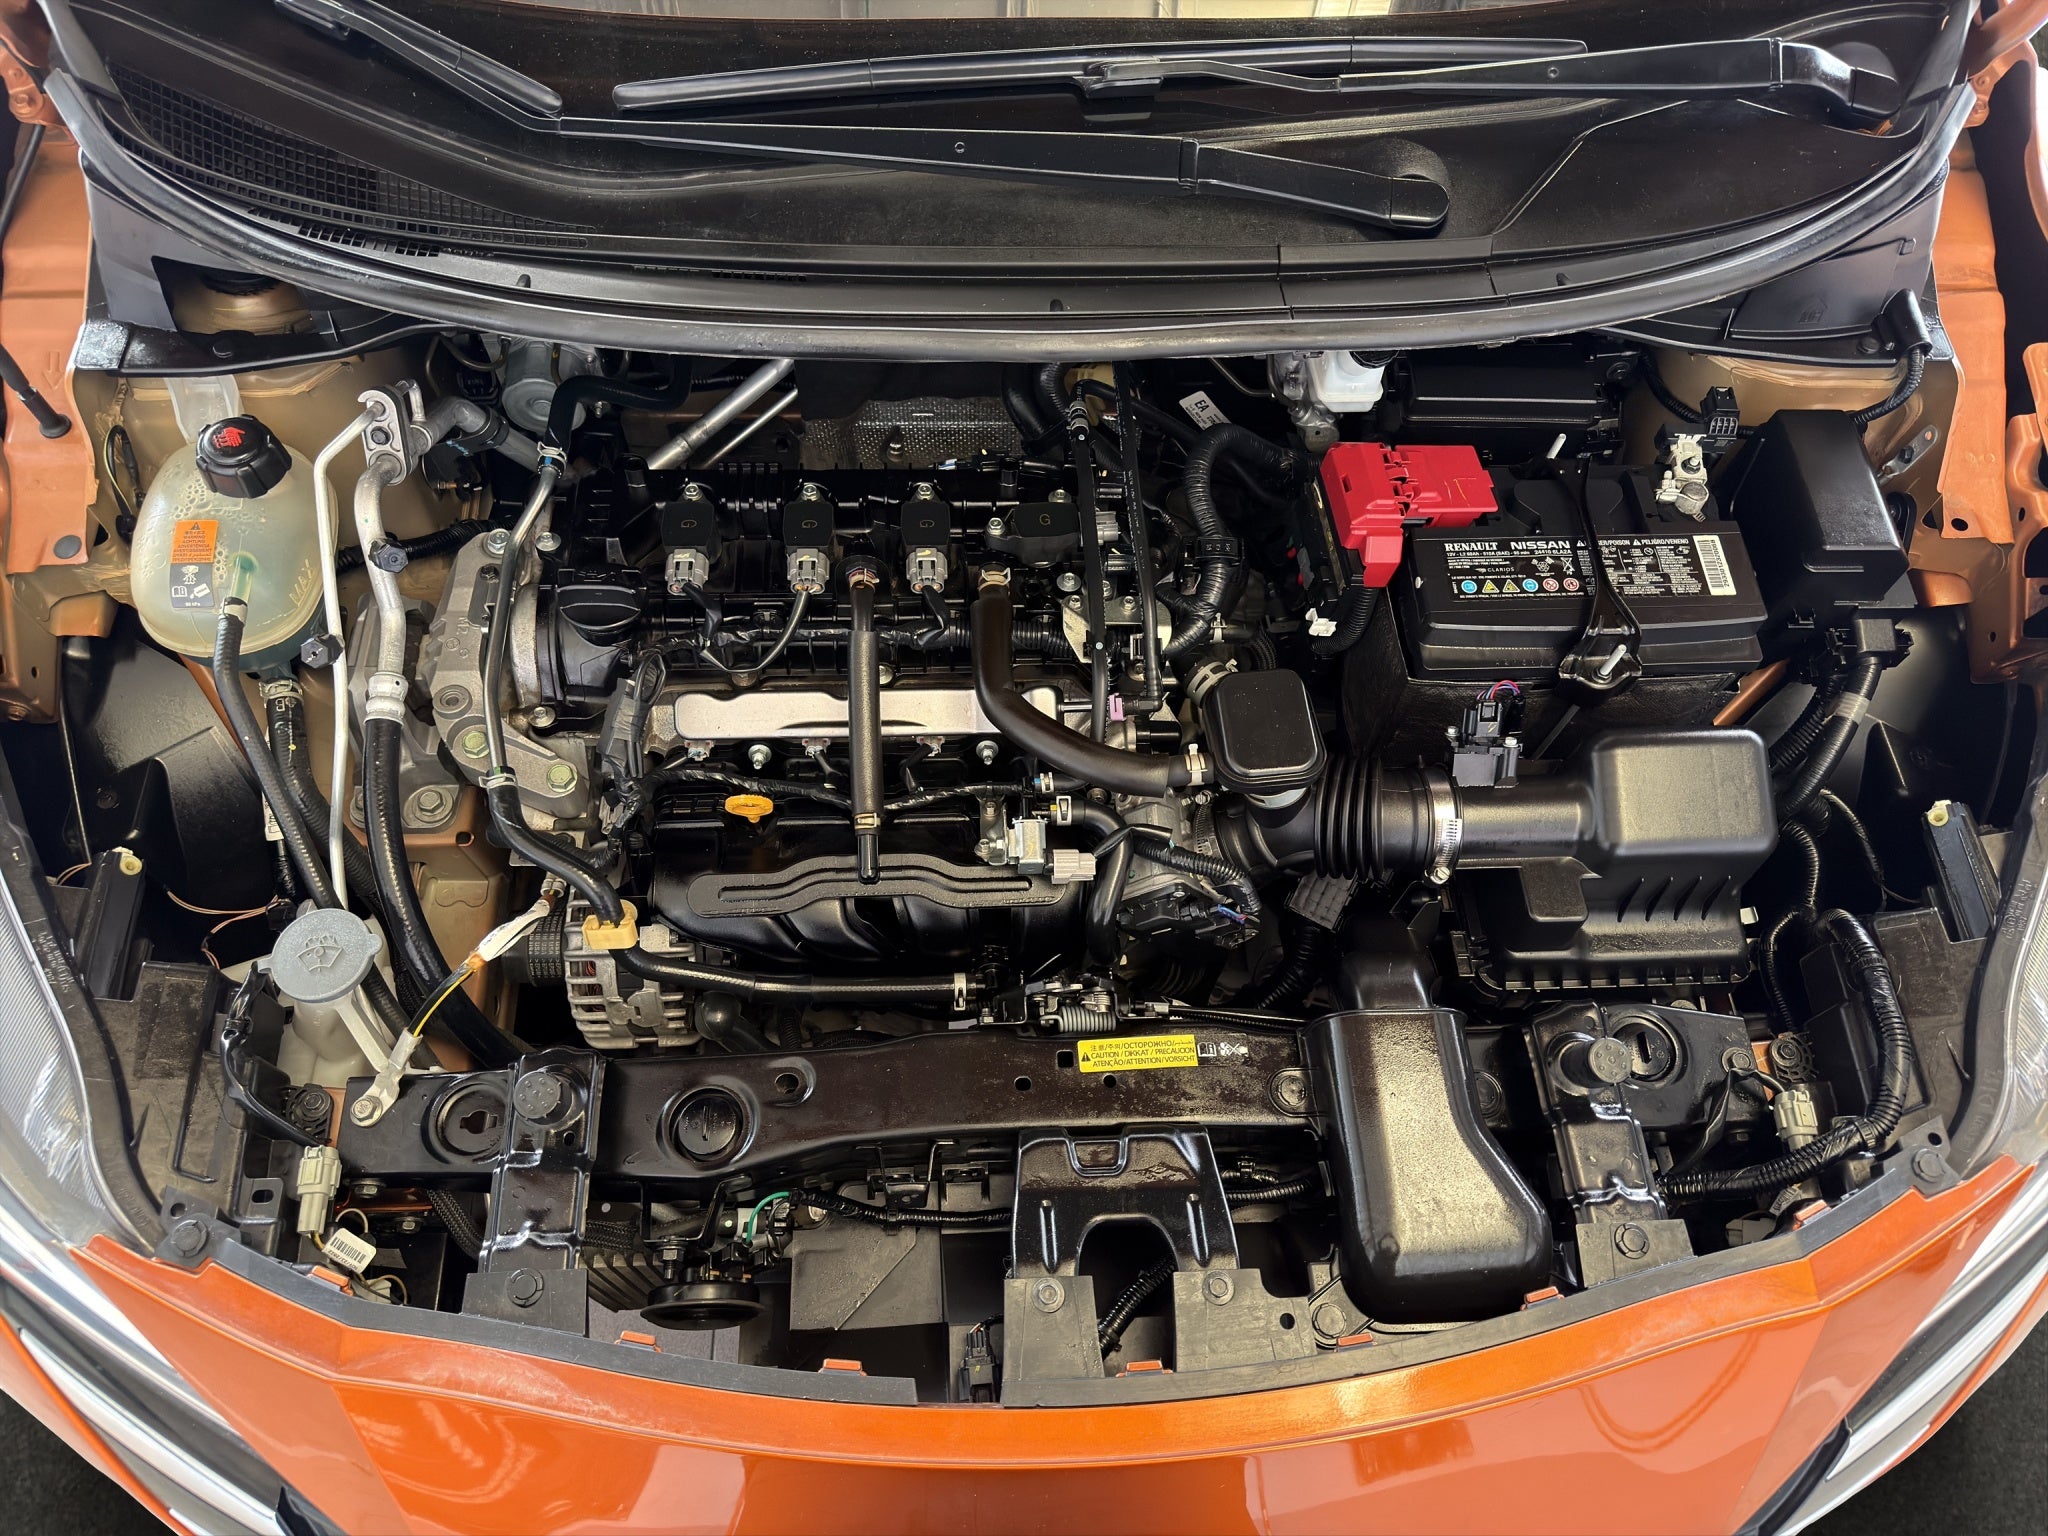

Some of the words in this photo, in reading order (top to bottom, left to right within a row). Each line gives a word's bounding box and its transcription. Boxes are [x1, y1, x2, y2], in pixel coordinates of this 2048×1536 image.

[1194, 399, 1210, 412] EA
[1444, 542, 1498, 552] RENAULT
[1510, 540, 1571, 550] NISSAN
[1091, 1051, 1119, 1060] CAUTION
